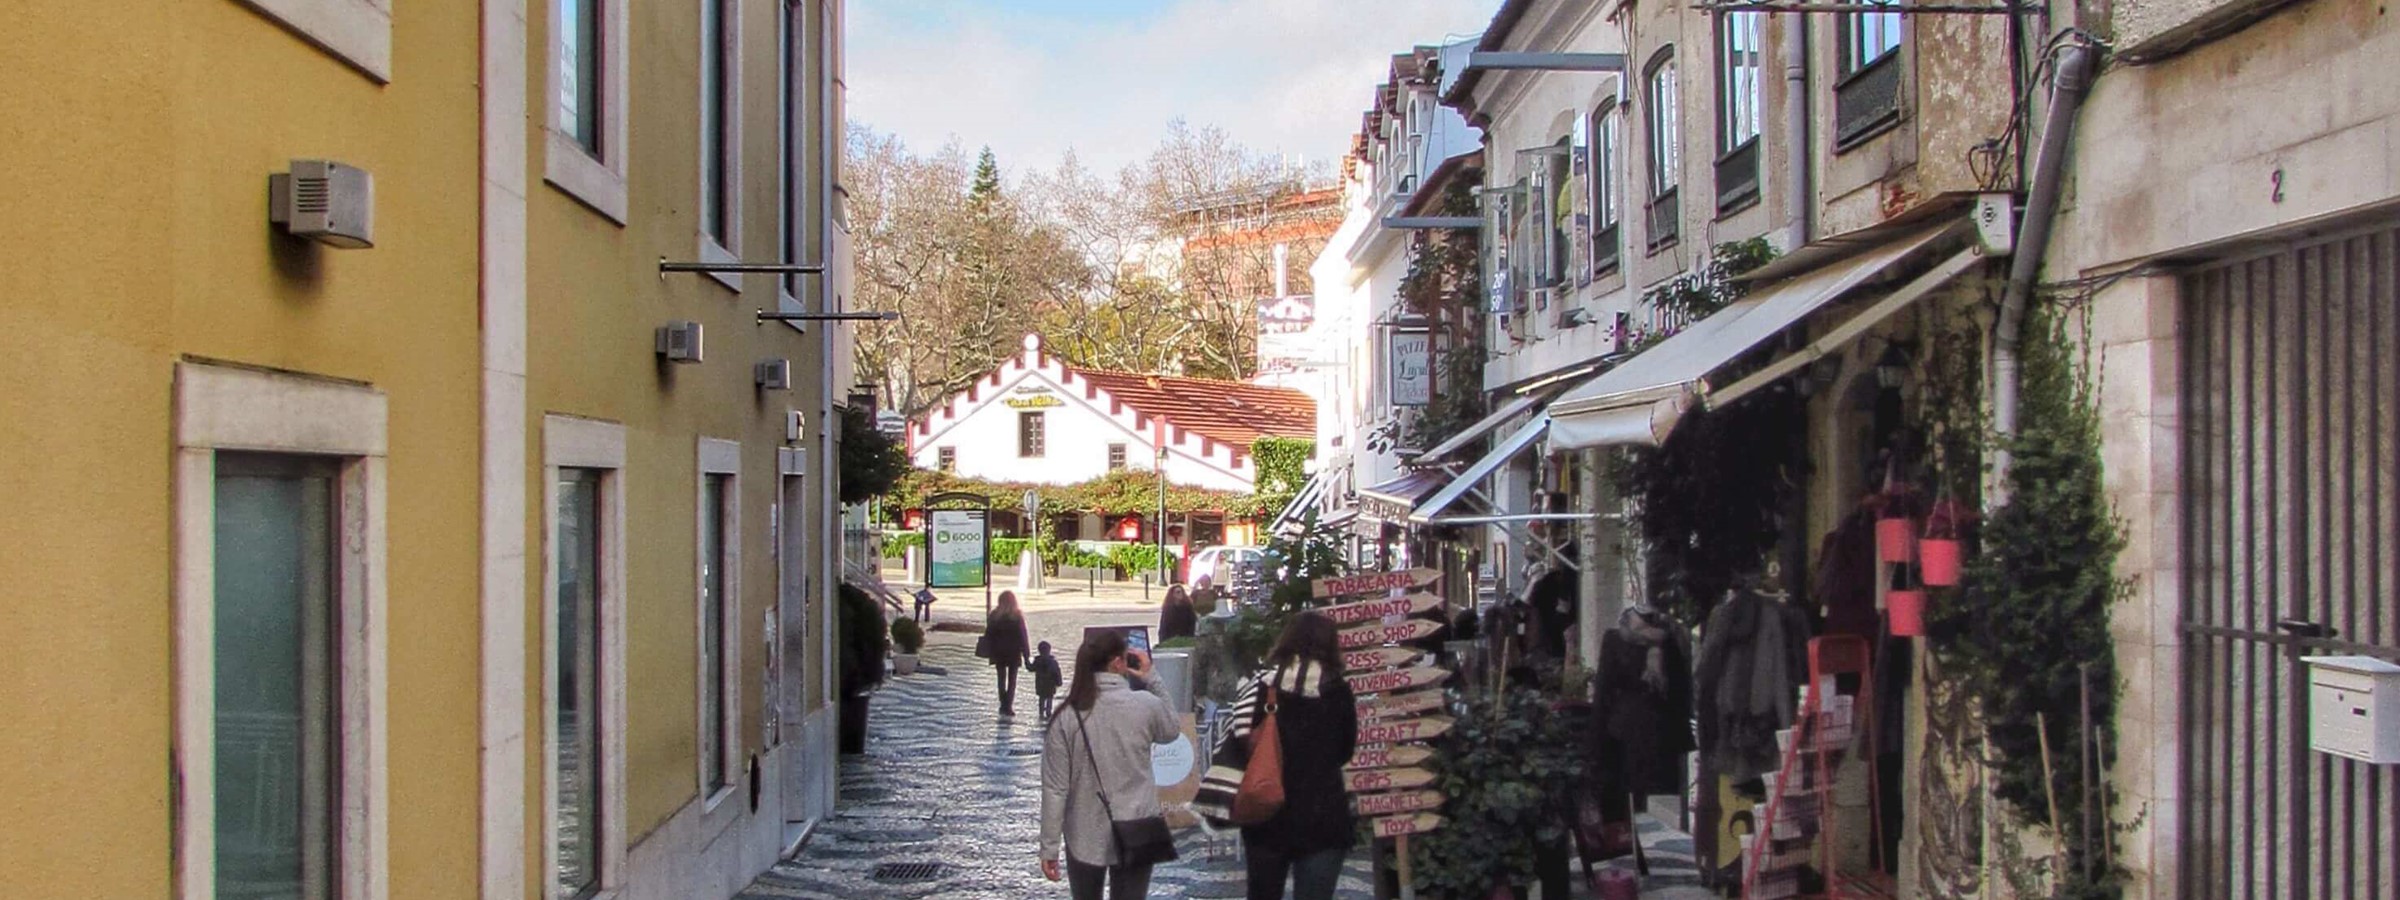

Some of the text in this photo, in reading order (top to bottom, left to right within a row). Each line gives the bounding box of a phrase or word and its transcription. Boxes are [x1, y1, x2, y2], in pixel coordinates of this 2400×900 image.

[2271, 168, 2285, 203] 2
[952, 532, 981, 541] 6000
[1324, 573, 1415, 595] TABACARIA
[1325, 599, 1412, 622] RTESANATO
[1338, 624, 1416, 647] ACCO SHOP
[1344, 652, 1380, 668] RESS
[1348, 671, 1412, 690] OUVENIRS
[1357, 723, 1421, 744] DICRAFT
[1350, 750, 1390, 767] CORK
[1361, 795, 1423, 811] MAGNETS
